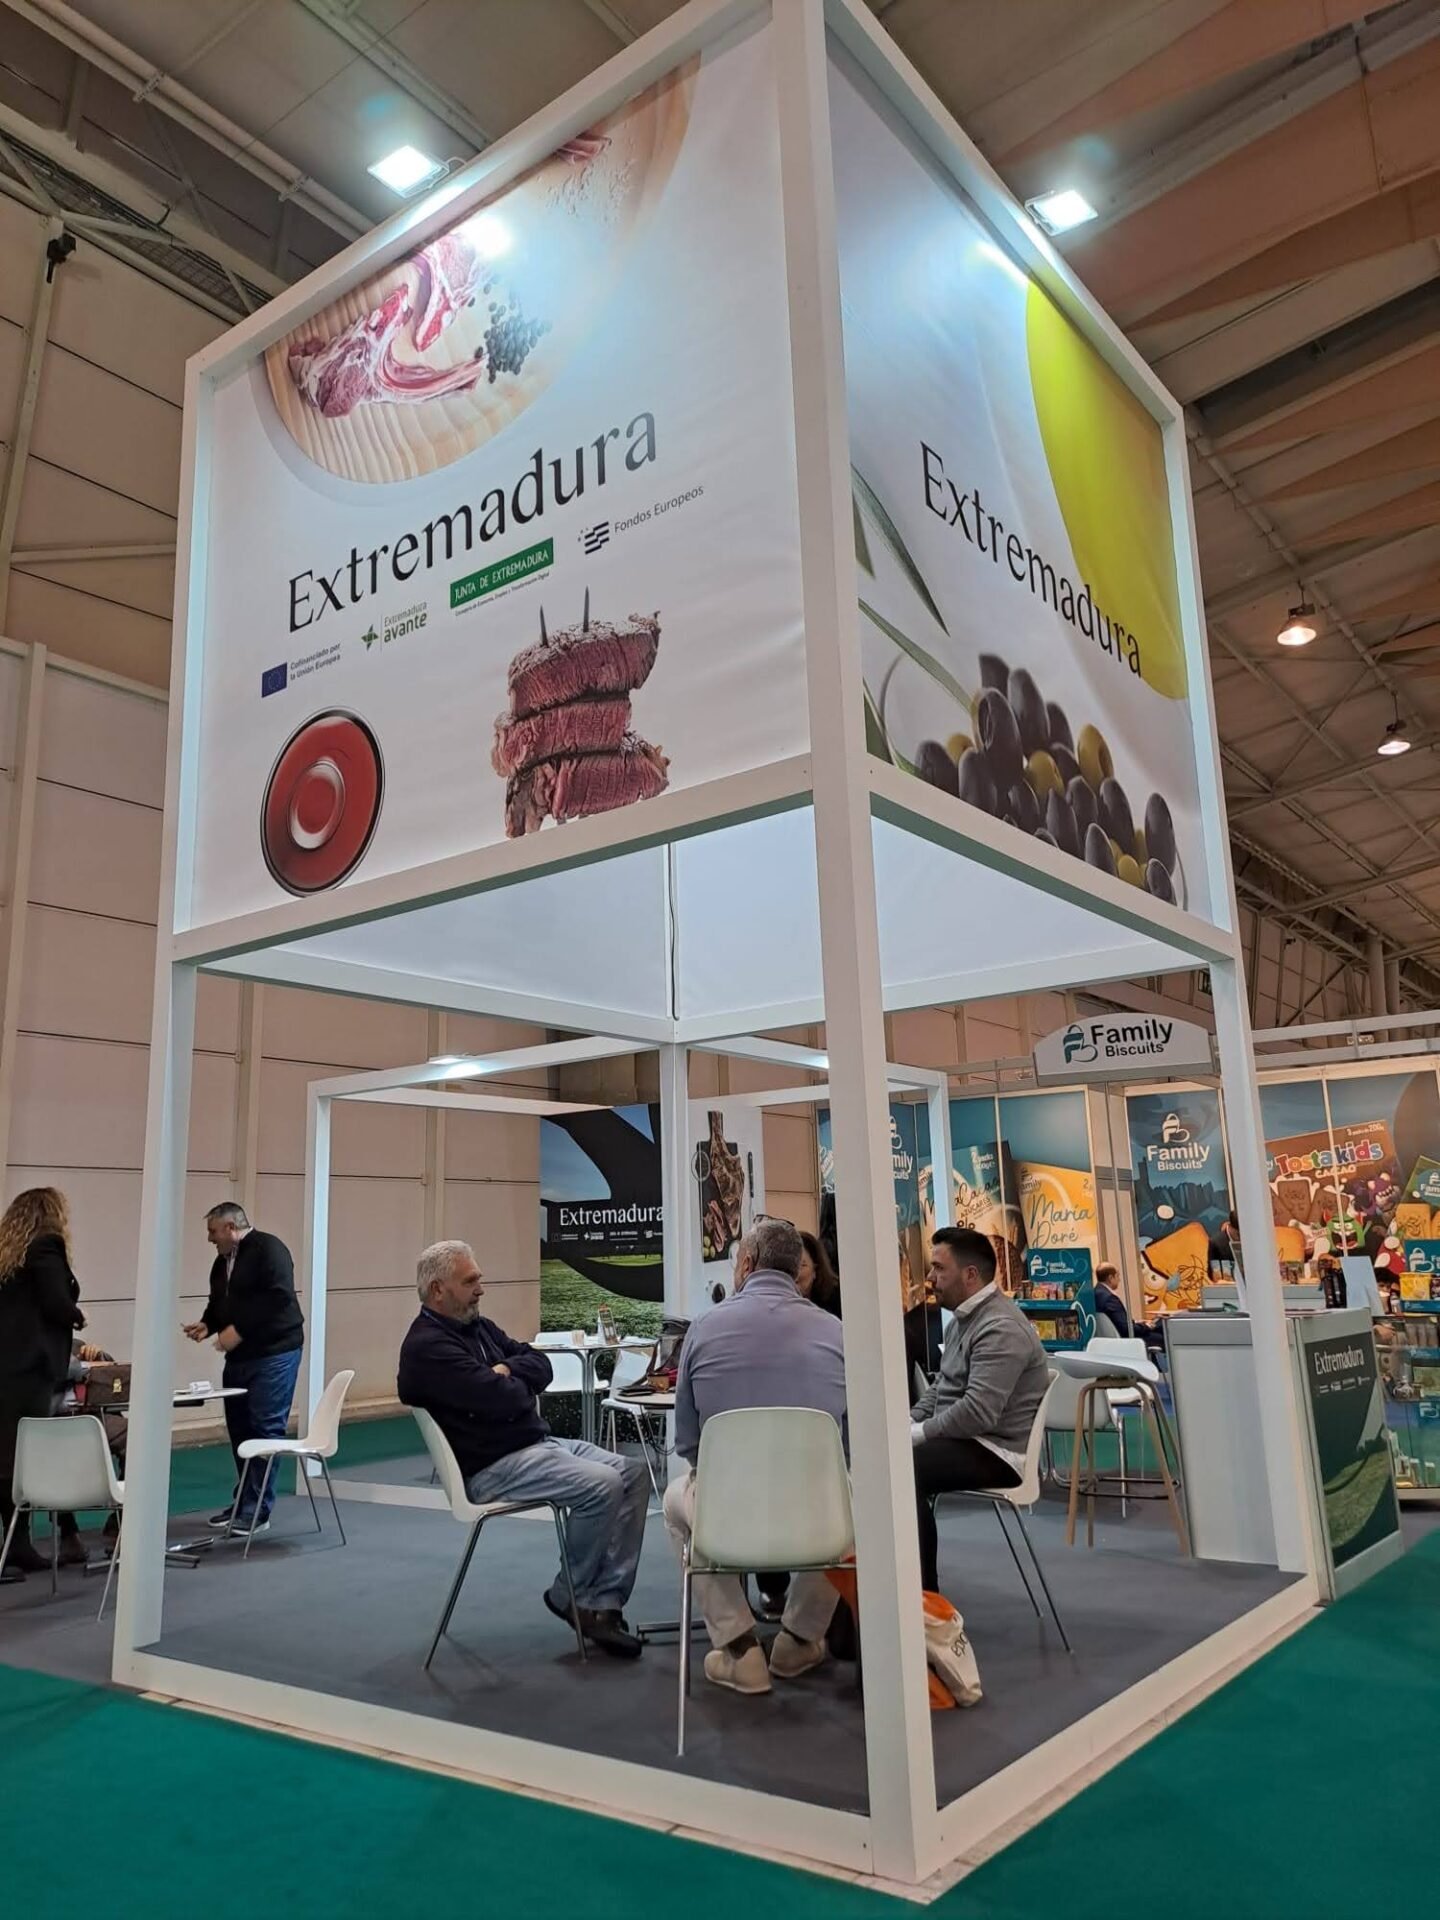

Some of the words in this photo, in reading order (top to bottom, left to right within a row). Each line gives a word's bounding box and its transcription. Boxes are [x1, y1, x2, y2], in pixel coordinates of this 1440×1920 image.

[614, 512, 652, 534] Fondos
[654, 485, 704, 516] Europeos
[288, 412, 656, 634] Extremadura
[920, 440, 1141, 678] Extremadura
[454, 581, 476, 603] JUNTA
[480, 574, 489, 589] DE
[492, 549, 549, 584] EXTREMADURA
[384, 601, 428, 627] Extremadura
[384, 613, 428, 643] avante
[290, 646, 329, 670] Cofinanciado
[315, 654, 341, 670] Europea
[1091, 1019, 1173, 1045] Family
[1105, 1042, 1164, 1057] Biscuits
[892, 1150, 913, 1173] mily
[1147, 1141, 1210, 1162] Family
[1157, 1160, 1202, 1171] Biscuits
[560, 1203, 663, 1226] Extremadura
[1032, 1220, 1078, 1249] Doré
[1314, 1345, 1364, 1376] Extremadura
